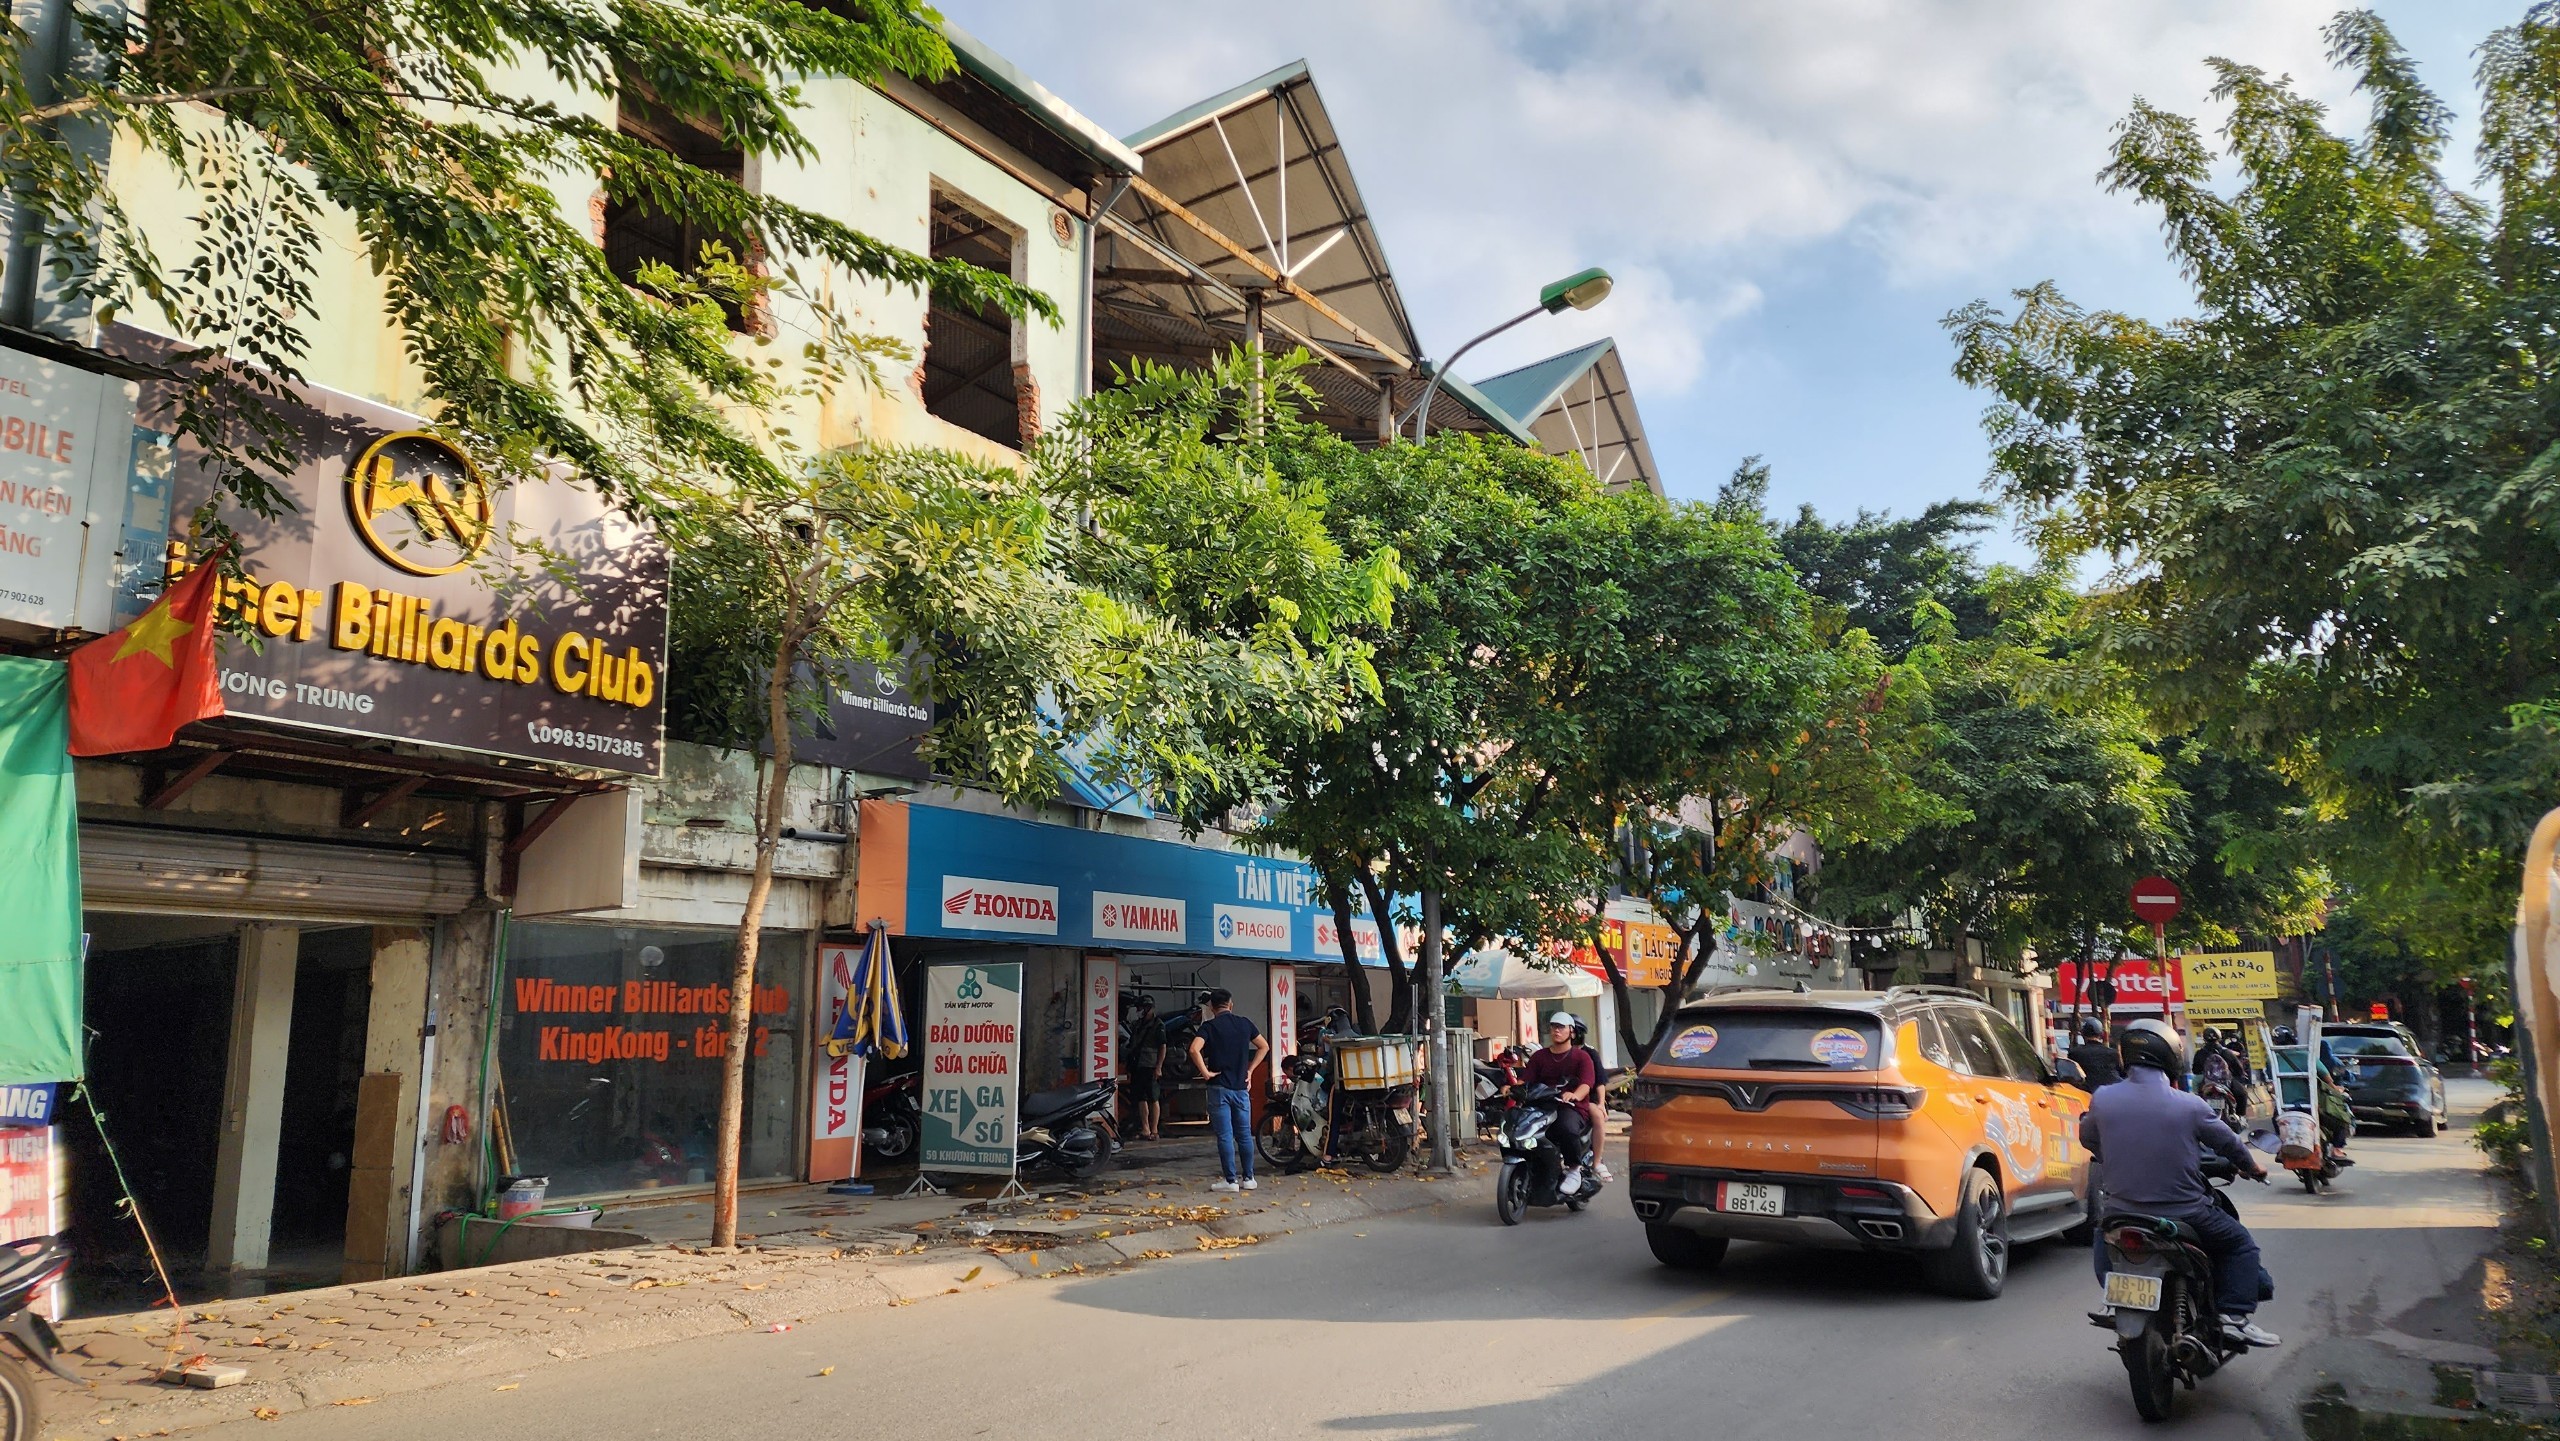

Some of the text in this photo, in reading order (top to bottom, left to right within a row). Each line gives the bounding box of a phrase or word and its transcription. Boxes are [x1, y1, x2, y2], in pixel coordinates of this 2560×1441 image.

[0, 415, 75, 464] BILE
[21, 484, 72, 518] KIỆN
[11, 590, 27, 603] 902
[28, 594, 44, 606] 628
[332, 581, 541, 685] Billiards
[551, 632, 655, 709] Club
[294, 682, 375, 715] TRUNG
[841, 689, 928, 721] Winner Billiards Club
[539, 726, 645, 760] 0983517385
[1236, 862, 1272, 902] TÂN
[1275, 868, 1312, 914] VIỆT
[973, 892, 1057, 922] HONDA
[1121, 904, 1179, 934] YAMAHA
[1236, 920, 1286, 940] PIAGGIO
[2192, 958, 2218, 976] TRÀ
[2230, 971, 2246, 979] AN
[515, 978, 790, 1014] Winner Billiards lub
[539, 1025, 669, 1064] KingKong
[754, 1026, 769, 1057] 2
[930, 1017, 1015, 1043] BẢO DƯỠNG
[934, 1048, 1008, 1075] SỬA CHỮA
[928, 1086, 1005, 1113] XE GA
[975, 1115, 1004, 1144] SỐ
[926, 1150, 938, 1160] 59
[978, 1152, 1008, 1164] TRUNG
[1686, 1138, 1812, 1152] VINFAST
[1731, 1198, 1776, 1213] 881.49
[1742, 1185, 1767, 1198] 30G
